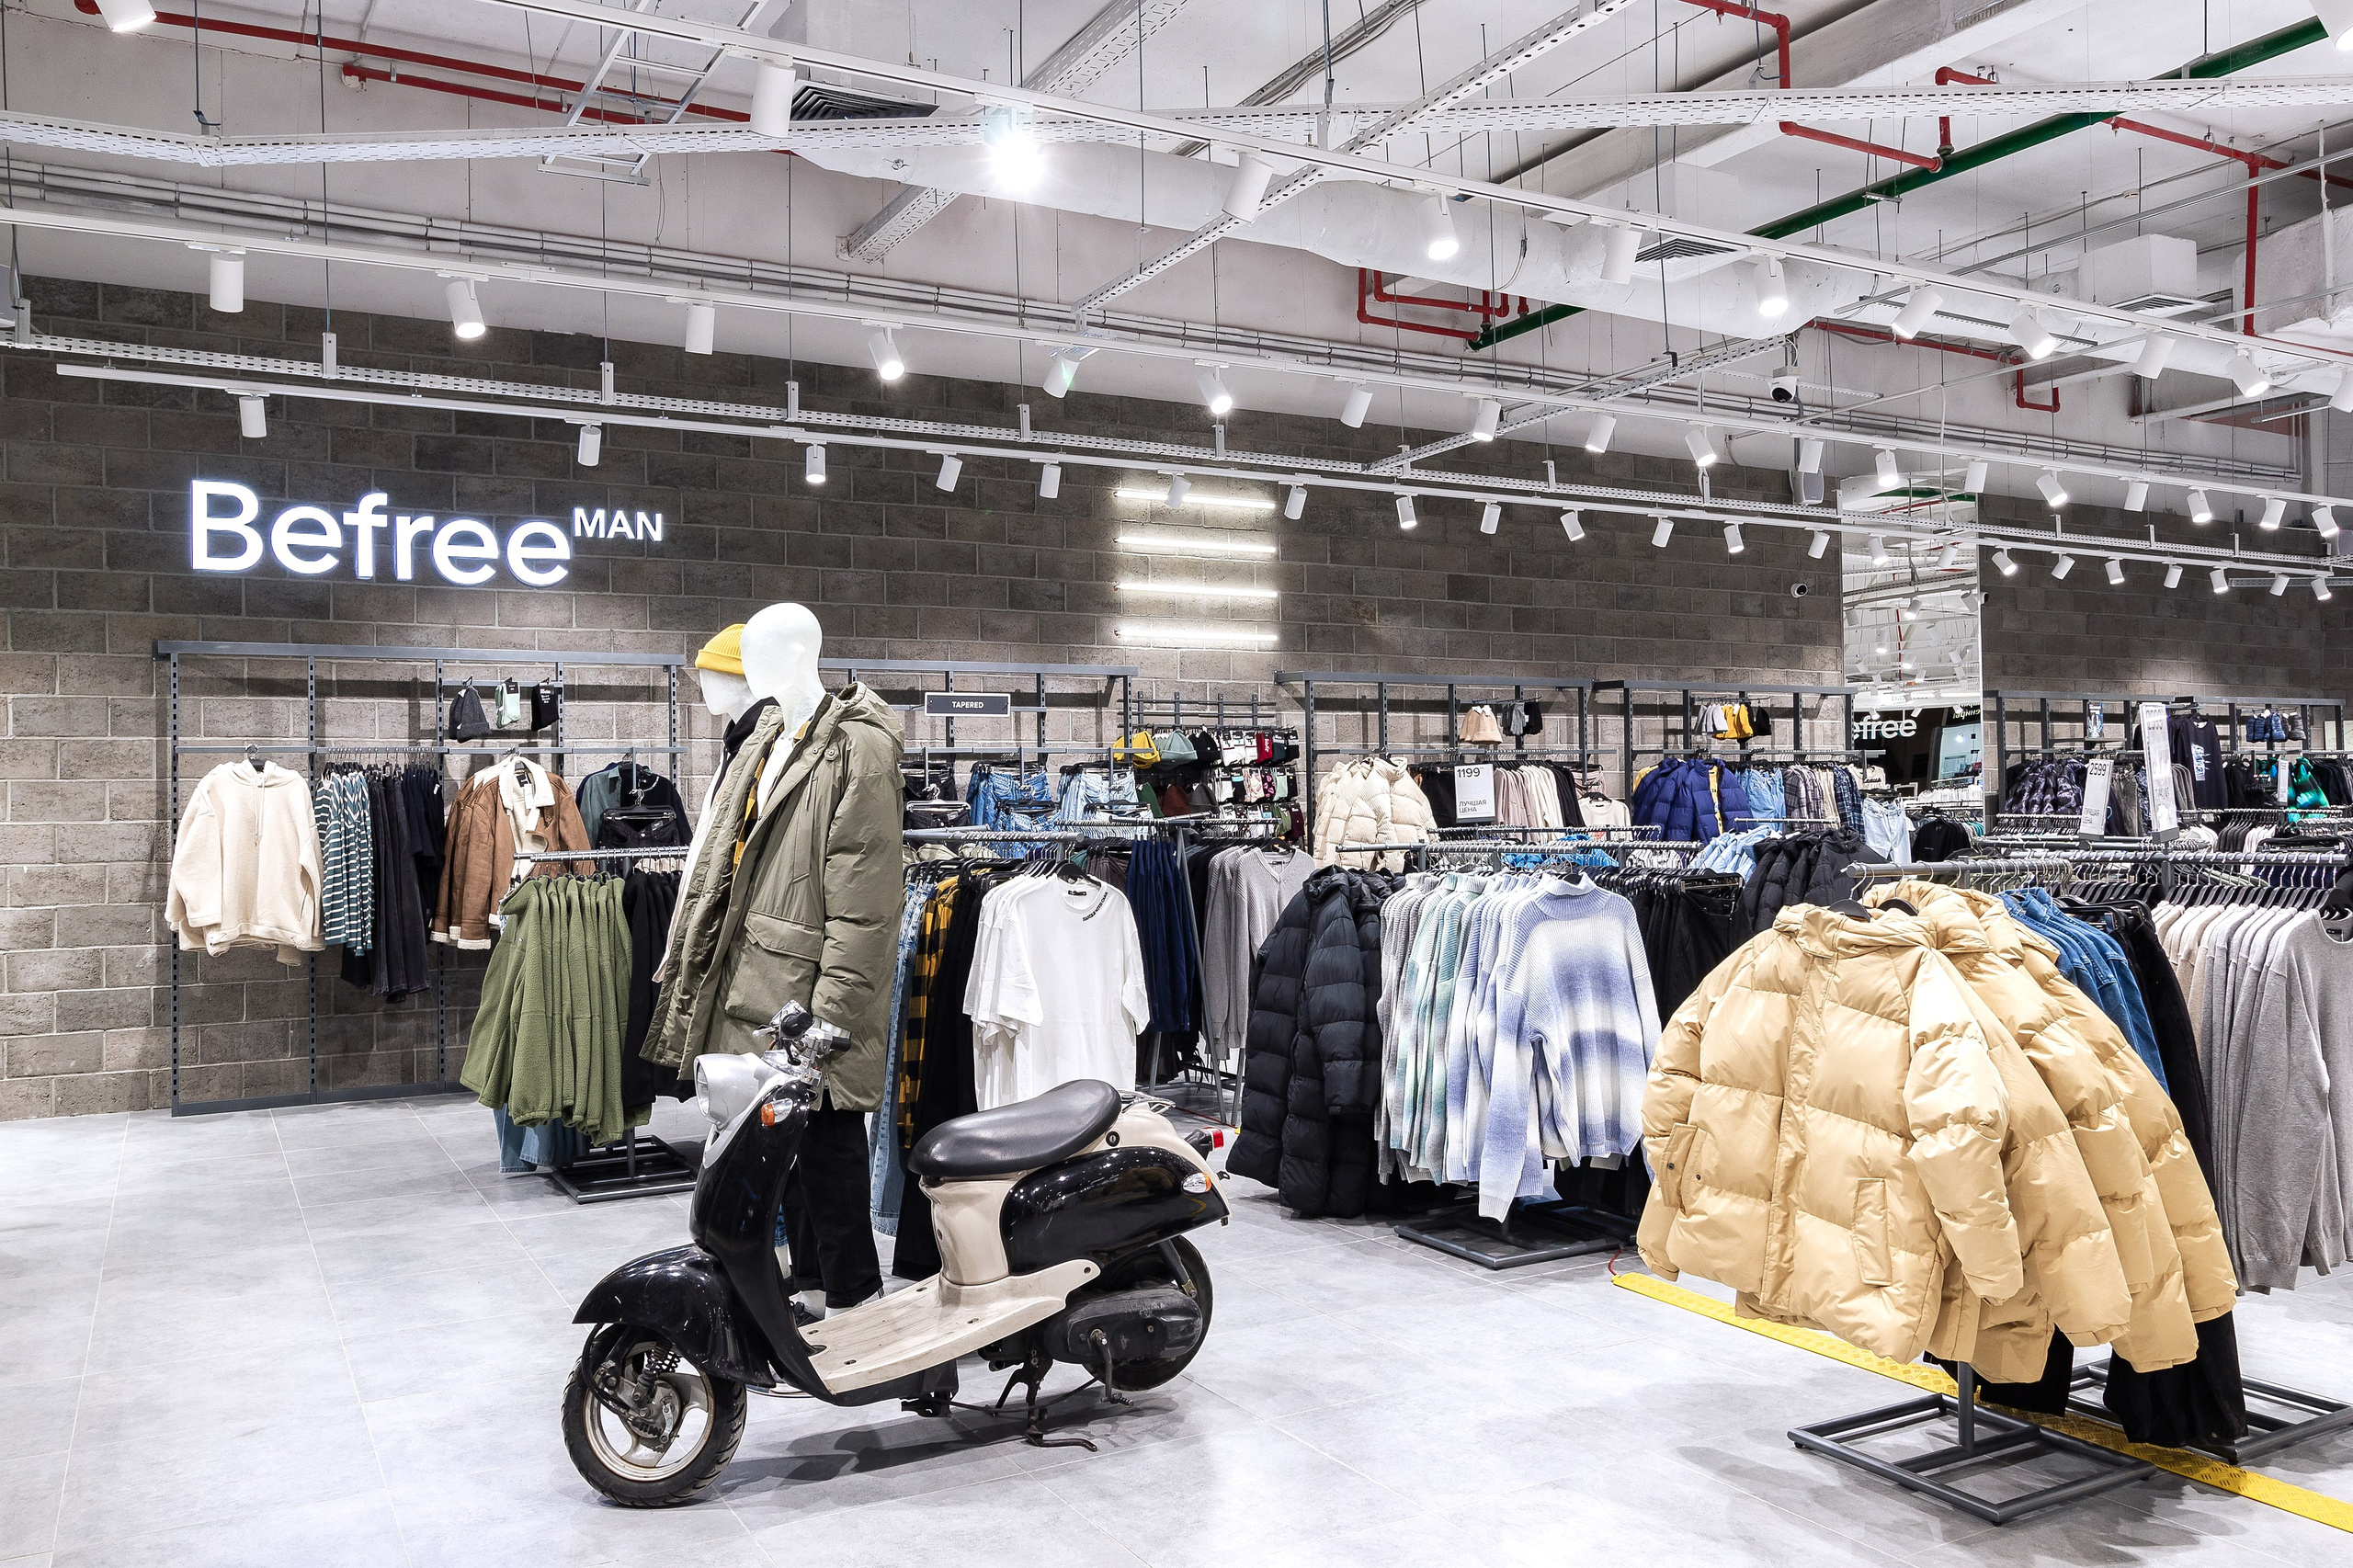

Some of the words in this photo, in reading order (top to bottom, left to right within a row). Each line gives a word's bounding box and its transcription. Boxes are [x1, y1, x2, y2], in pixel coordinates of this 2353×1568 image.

[190, 479, 571, 587] Befree
[573, 507, 664, 542] MAN
[1457, 767, 1481, 778] 1199
[2089, 763, 2107, 776] 2599
